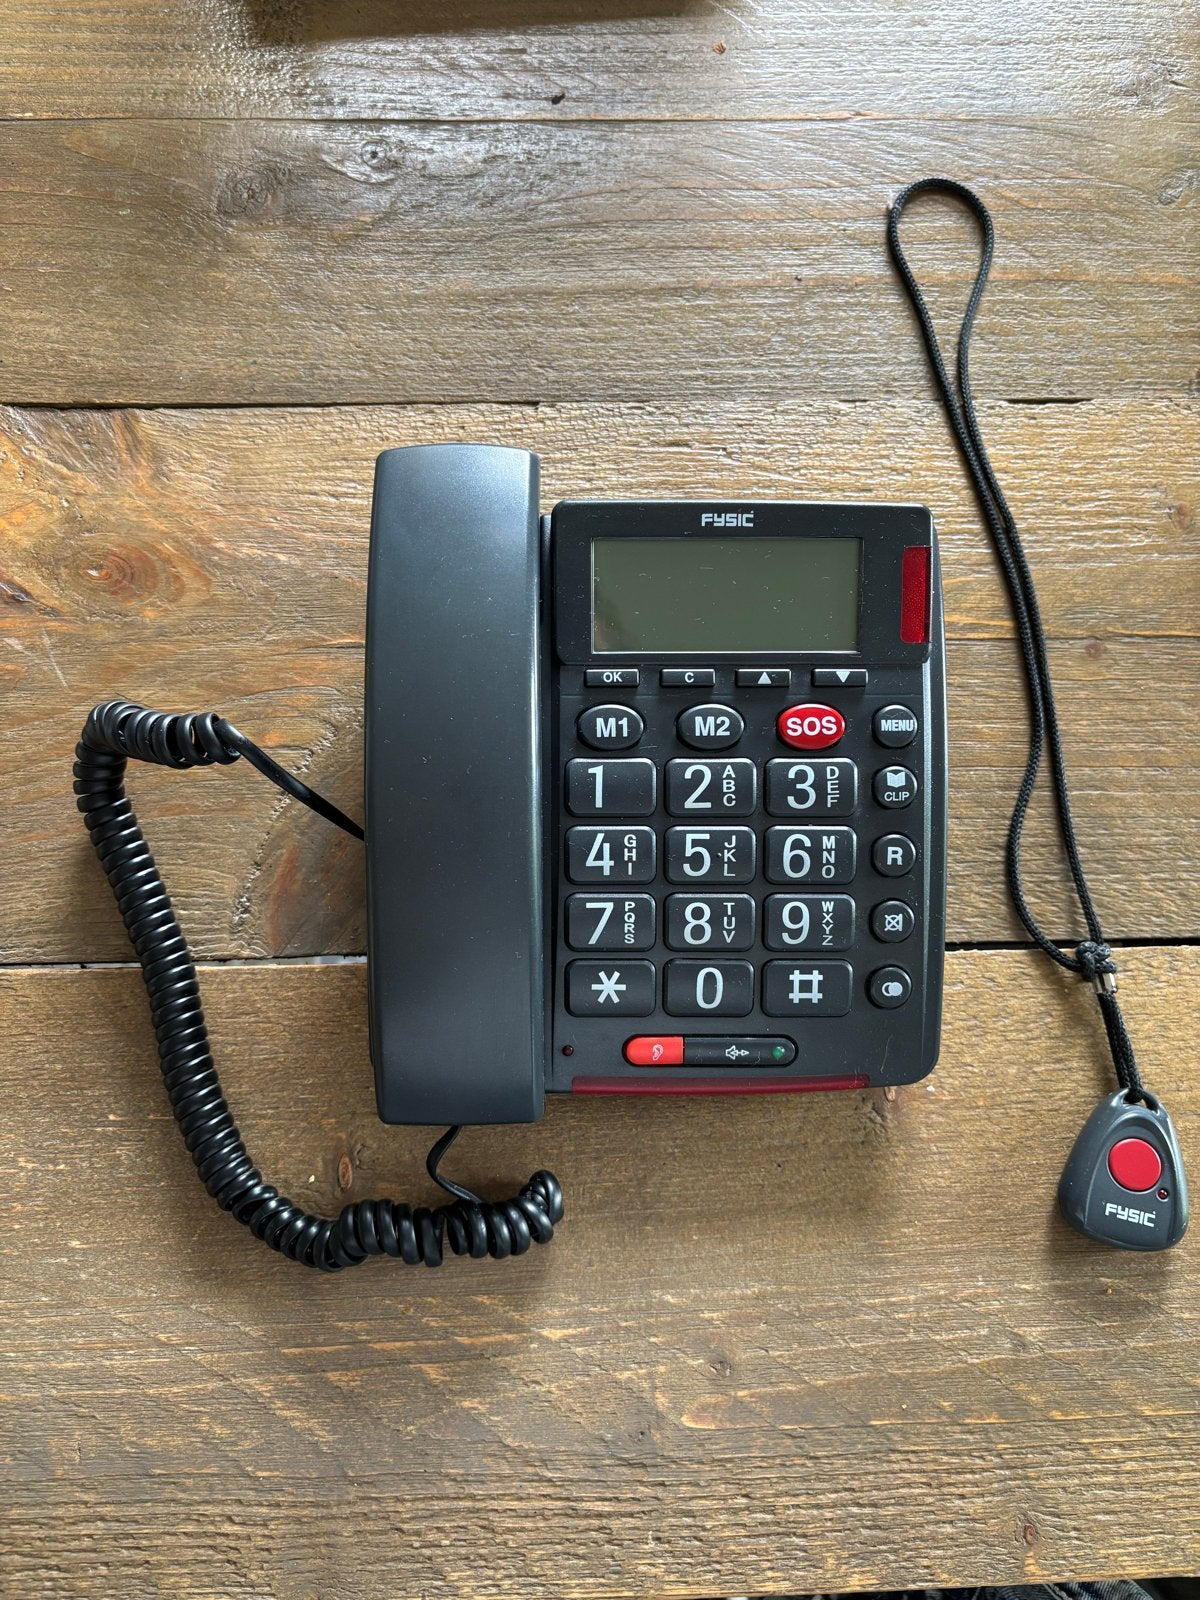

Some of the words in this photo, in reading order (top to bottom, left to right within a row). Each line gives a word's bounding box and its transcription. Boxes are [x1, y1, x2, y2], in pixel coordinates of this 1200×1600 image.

[701, 513, 754, 527] FYSIC
[602, 671, 623, 682] OK
[685, 671, 694, 682] C
[597, 718, 627, 737] M1
[695, 716, 730, 736] M2
[787, 716, 836, 736] SOS
[881, 719, 914, 731] MENU
[587, 764, 604, 808] 1
[684, 765, 711, 808] 2
[787, 765, 815, 809] 3
[884, 791, 909, 802] CLIP
[586, 833, 614, 875] 4
[683, 834, 710, 876] 5
[783, 834, 811, 877] 6
[887, 847, 902, 865] R
[586, 902, 613, 944] 7
[684, 902, 711, 944] 8
[782, 902, 809, 944] 9
[697, 968, 723, 1008] 0
[1105, 1203, 1156, 1227] FYSIC
